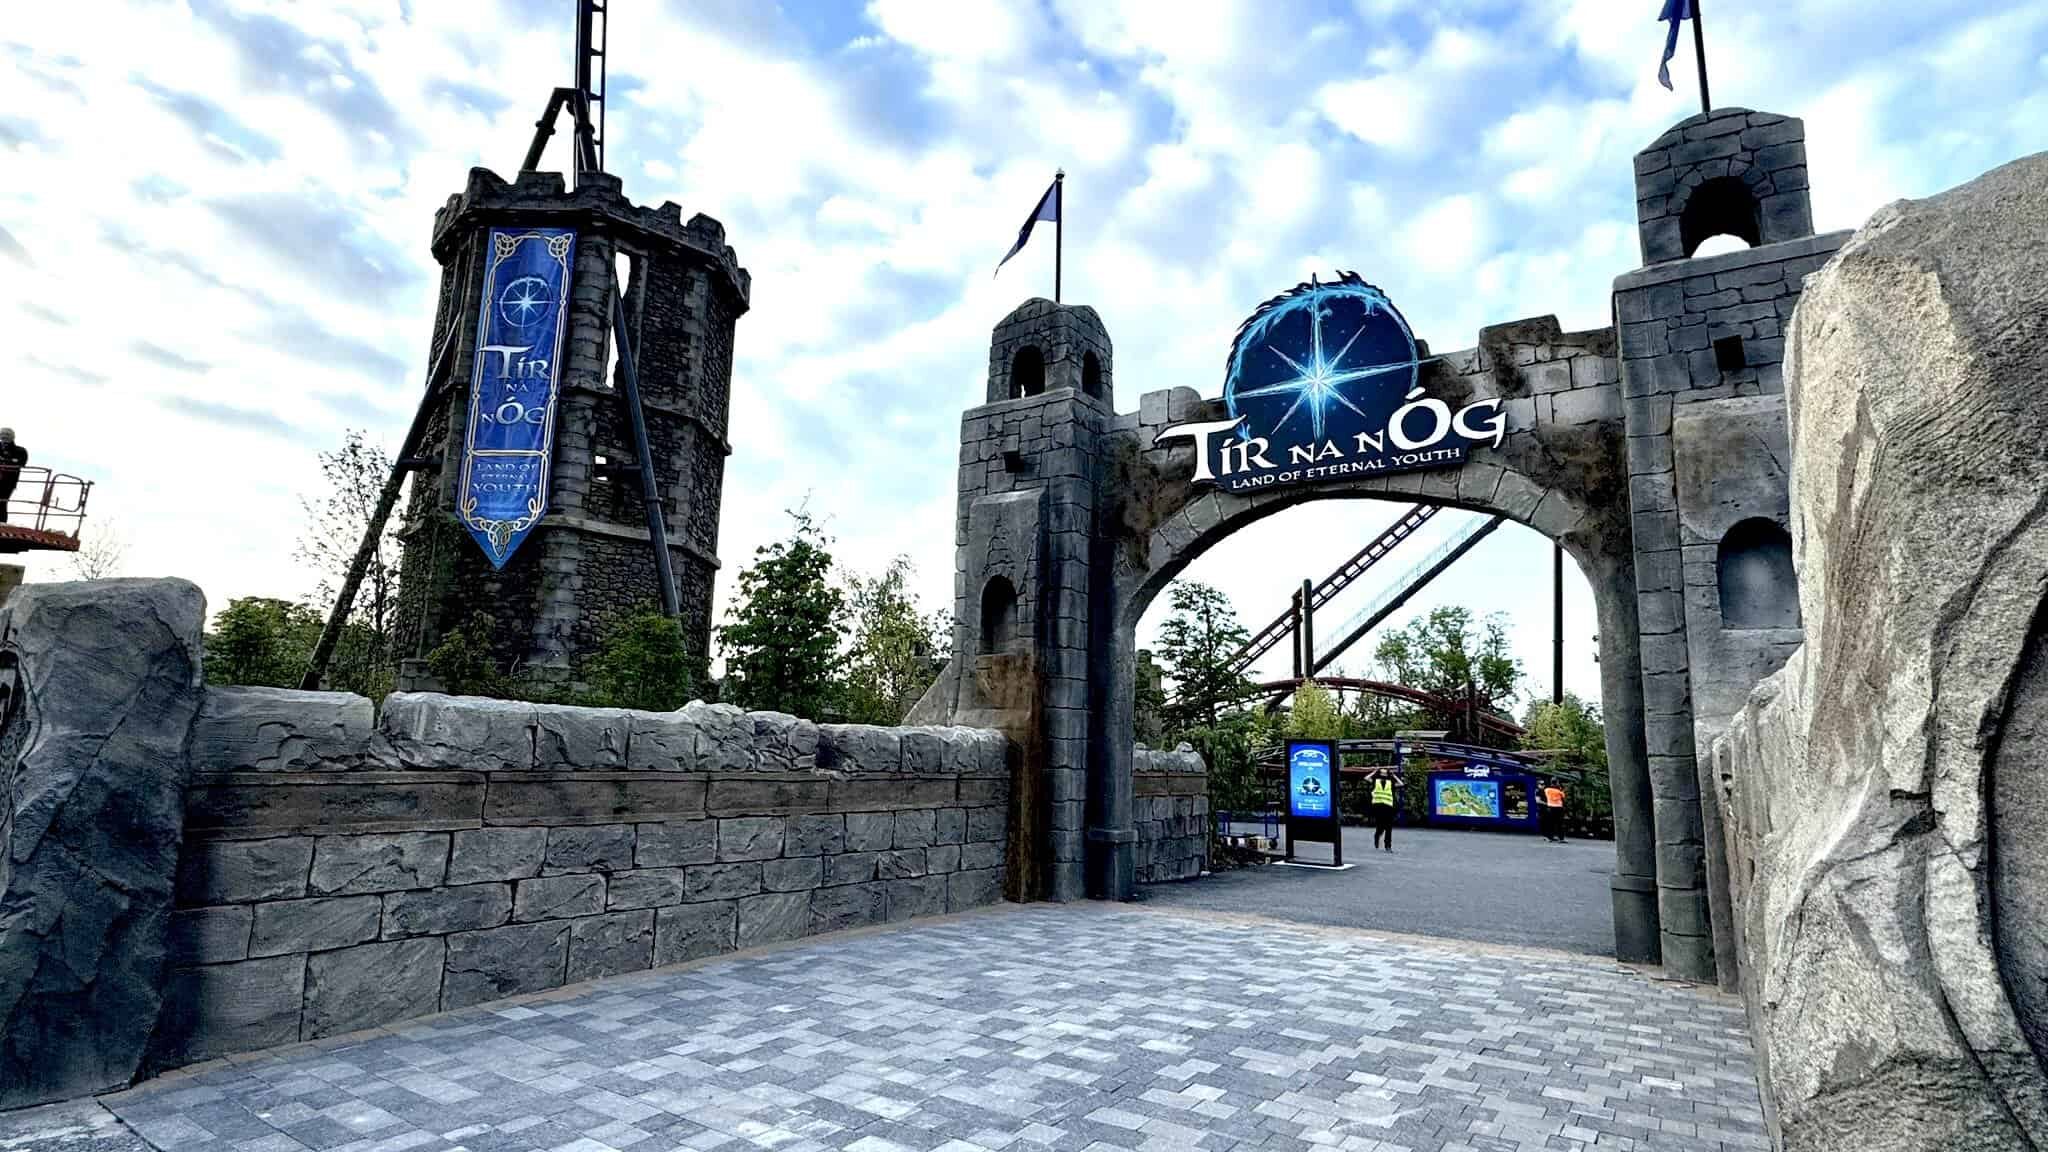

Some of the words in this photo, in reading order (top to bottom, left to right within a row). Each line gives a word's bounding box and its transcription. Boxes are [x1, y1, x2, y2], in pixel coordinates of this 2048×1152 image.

[506, 383, 529, 393] NA
[1288, 439, 1345, 466] NA
[477, 463, 516, 471] LAND
[519, 463, 539, 471] OF
[1232, 474, 1275, 489] LAND
[1278, 469, 1303, 483] OF
[1306, 459, 1386, 480] ETERNAL
[1391, 448, 1460, 466] YOUTH
[473, 482, 537, 493] YOUTH
